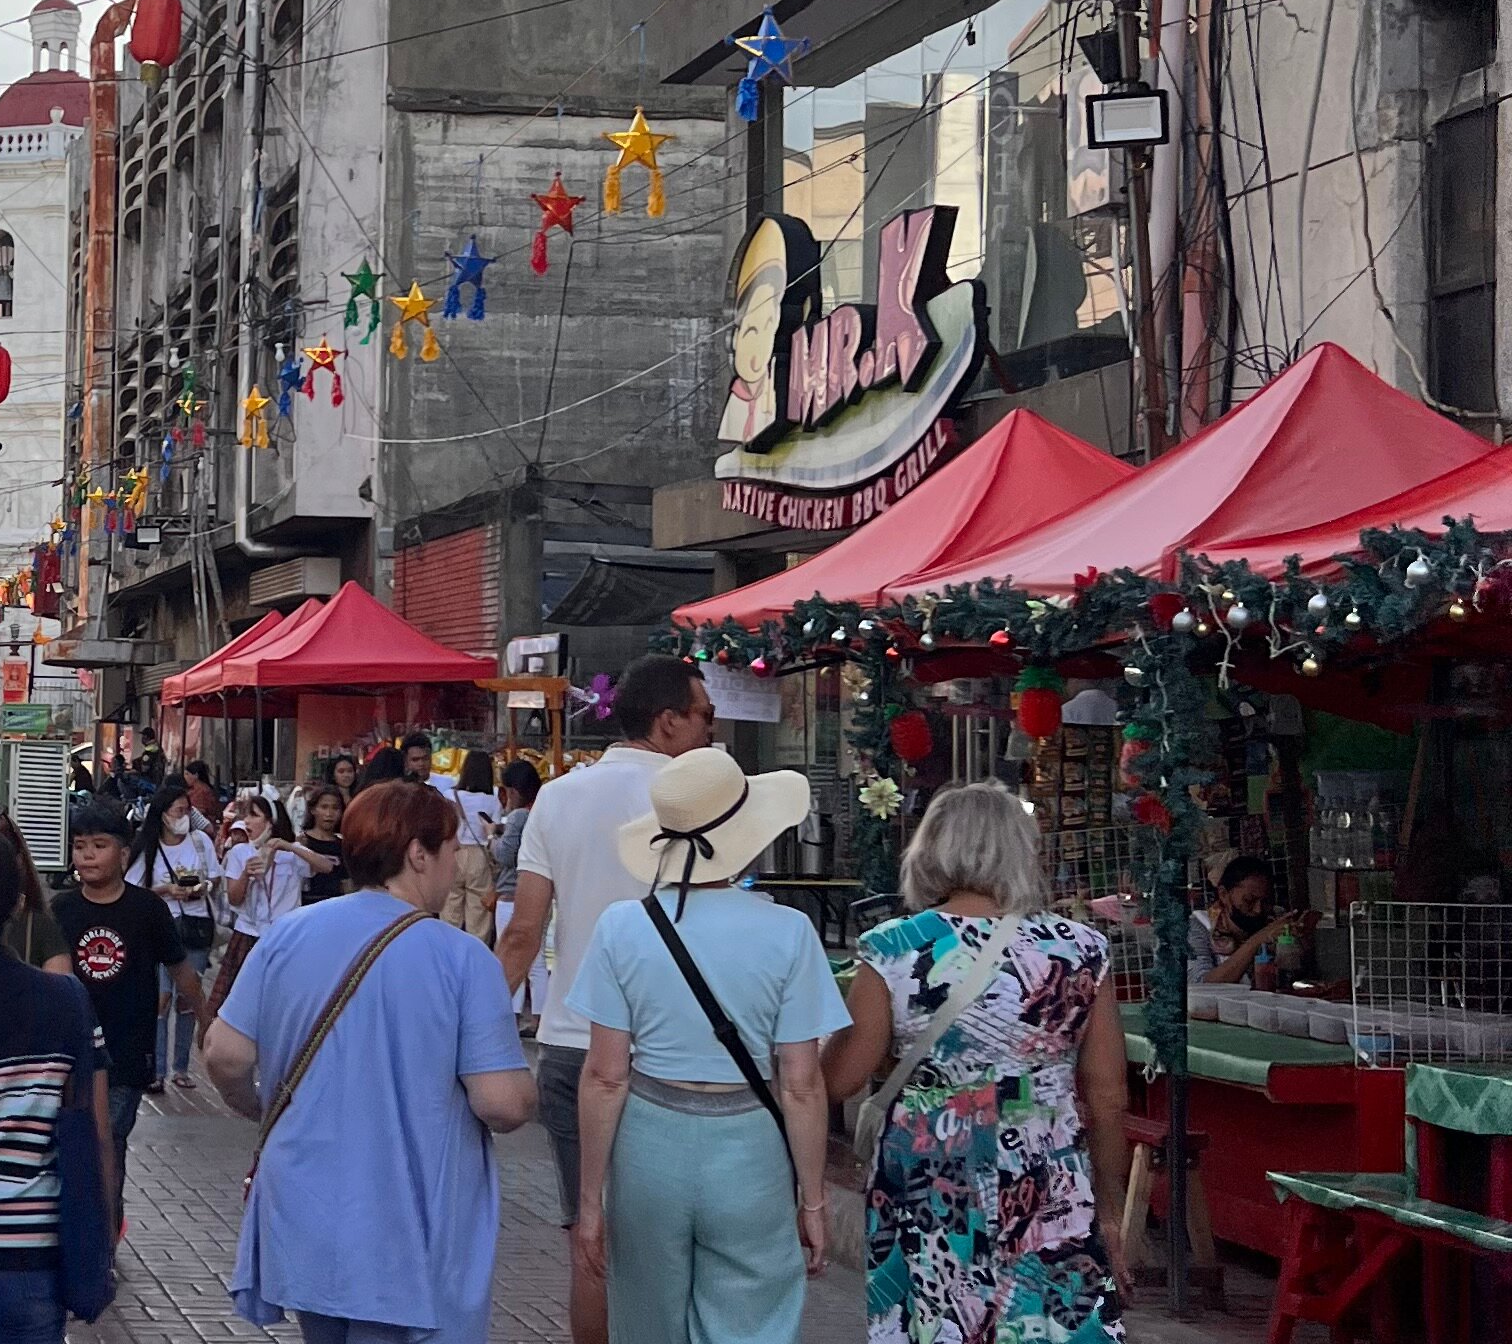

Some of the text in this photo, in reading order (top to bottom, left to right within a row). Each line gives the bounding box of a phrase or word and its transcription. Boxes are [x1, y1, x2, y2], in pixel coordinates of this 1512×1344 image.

[723, 423, 947, 531] NATIVE CHICKEN BBQ GRILL
[79, 929, 123, 948] WORLDWIDE
